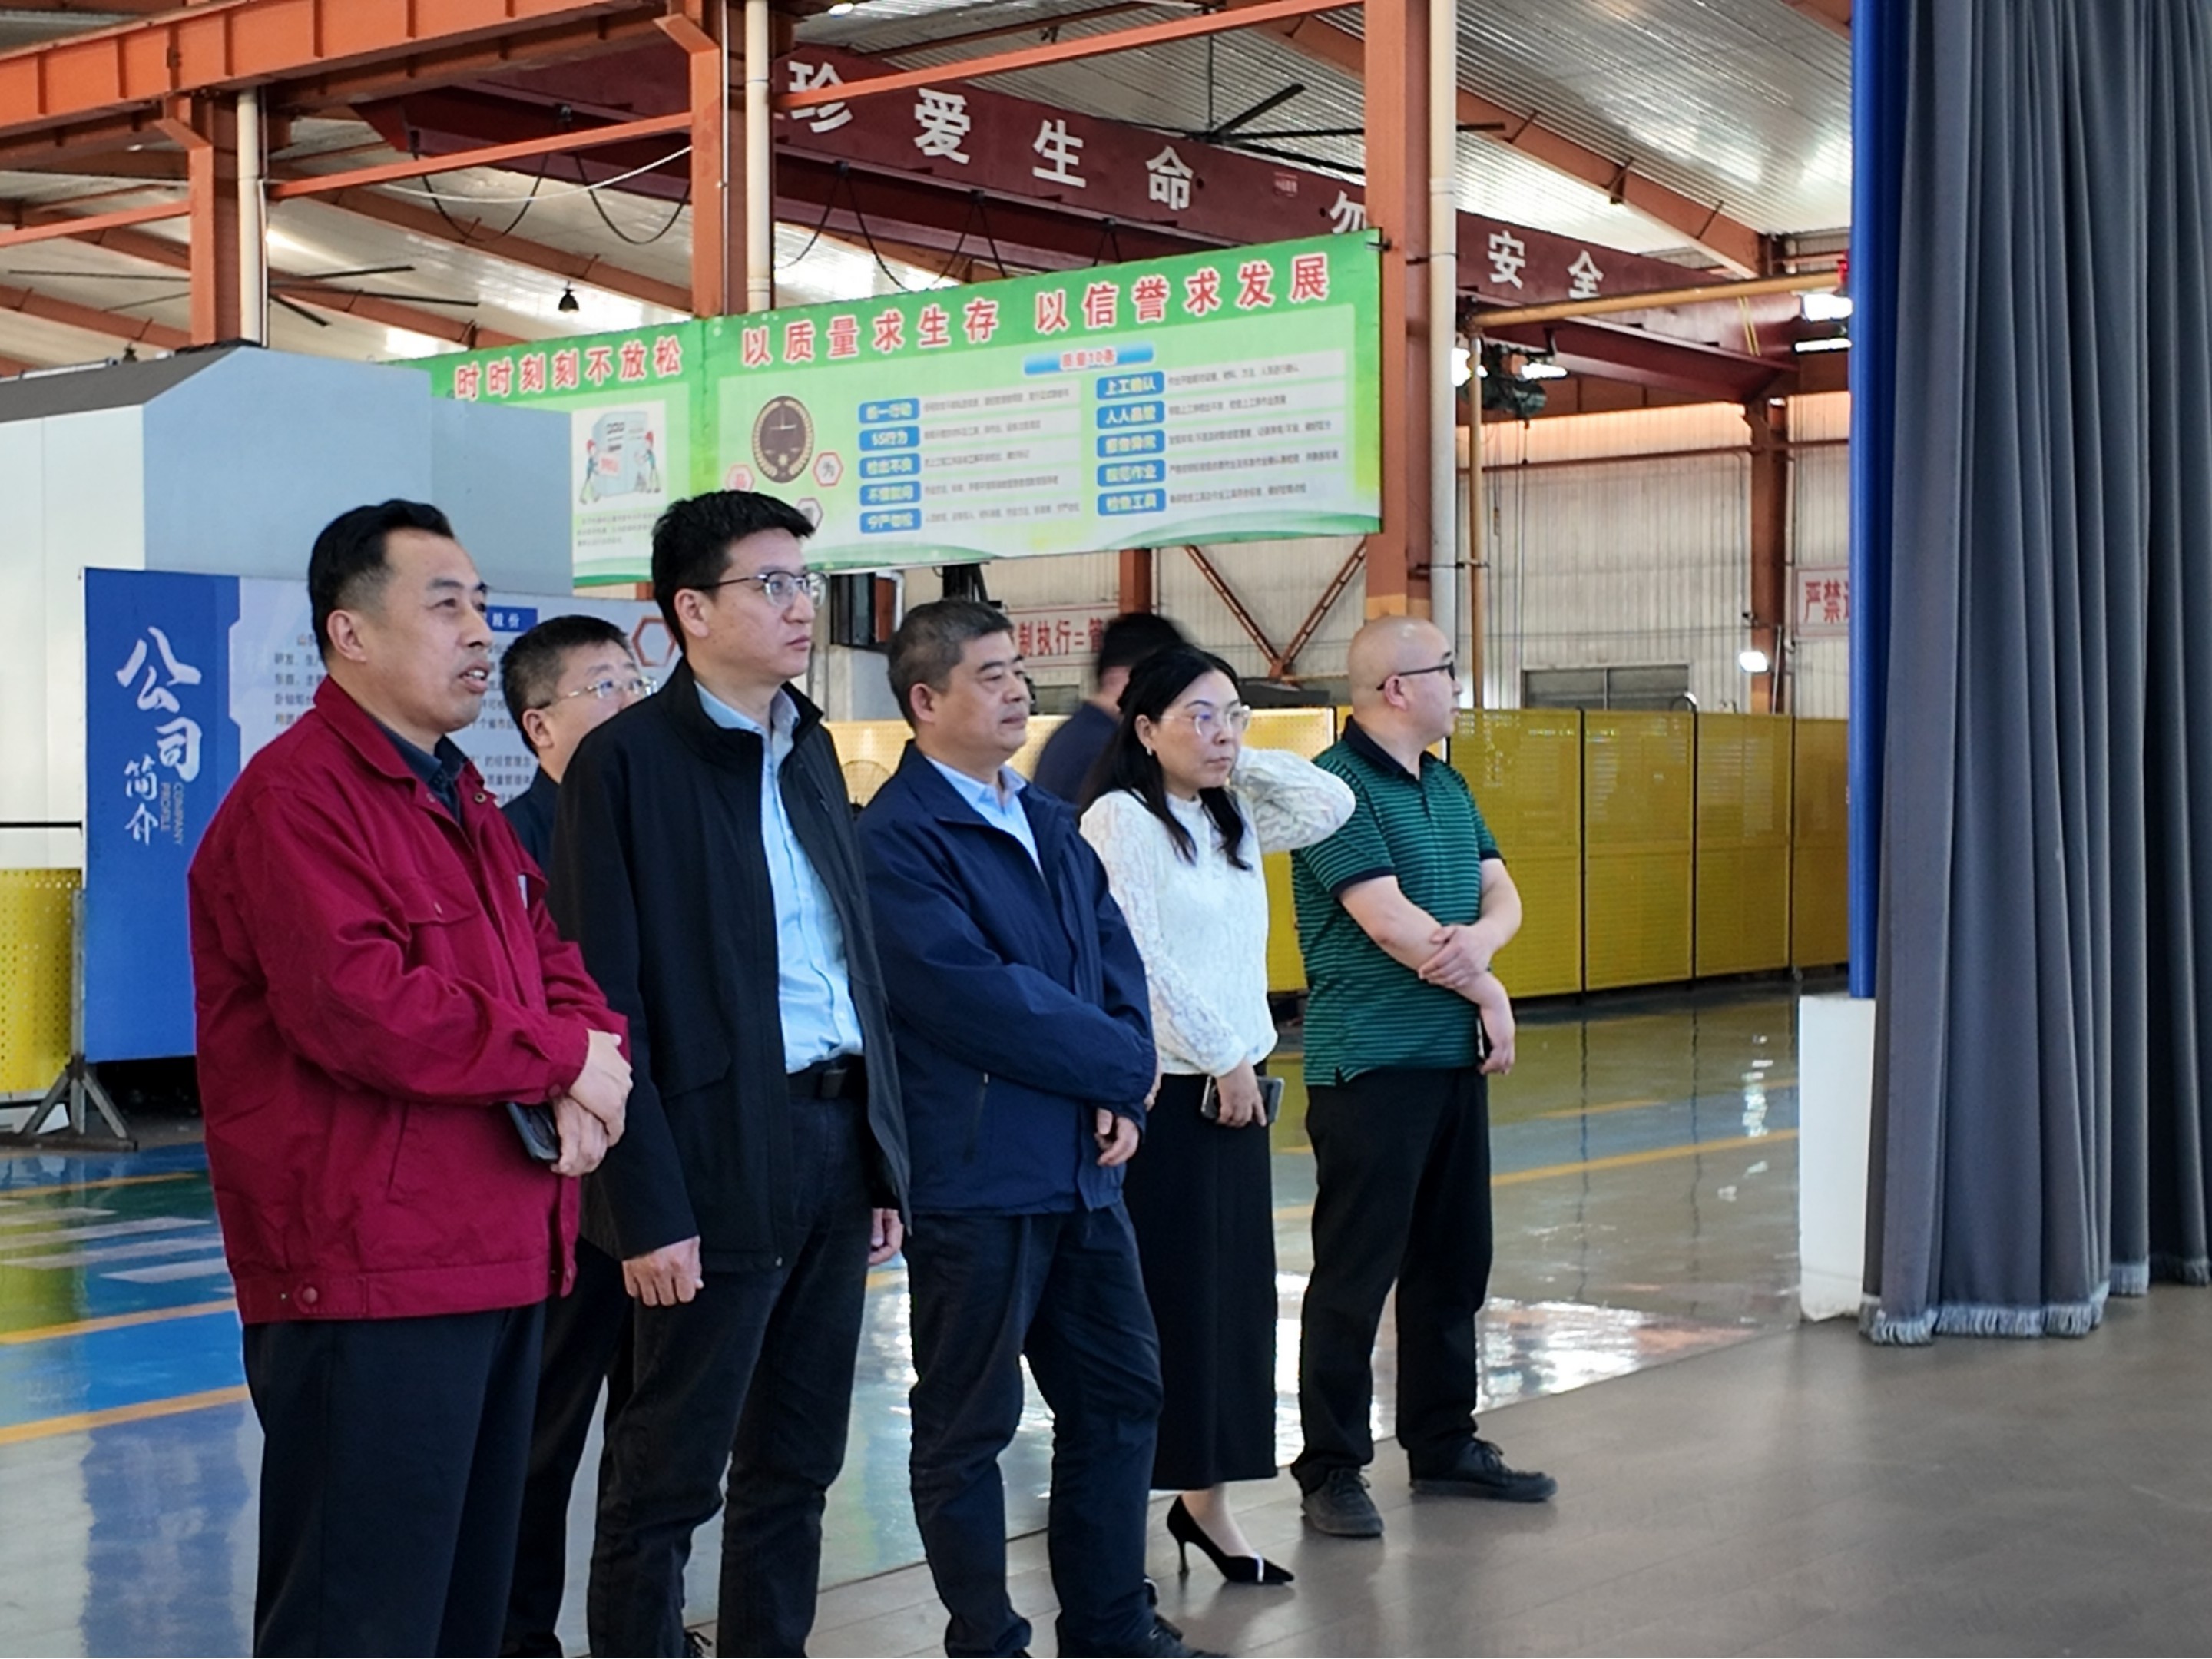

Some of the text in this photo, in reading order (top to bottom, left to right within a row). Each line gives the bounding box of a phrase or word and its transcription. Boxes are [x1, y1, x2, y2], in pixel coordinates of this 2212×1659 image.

[743, 255, 1327, 366] 以质量求生存 以信誉求发展
[1488, 230, 1604, 300] 安全
[456, 336, 683, 398] 时时刻刻不放松
[116, 626, 202, 782] 公司
[124, 753, 158, 845] 简介
